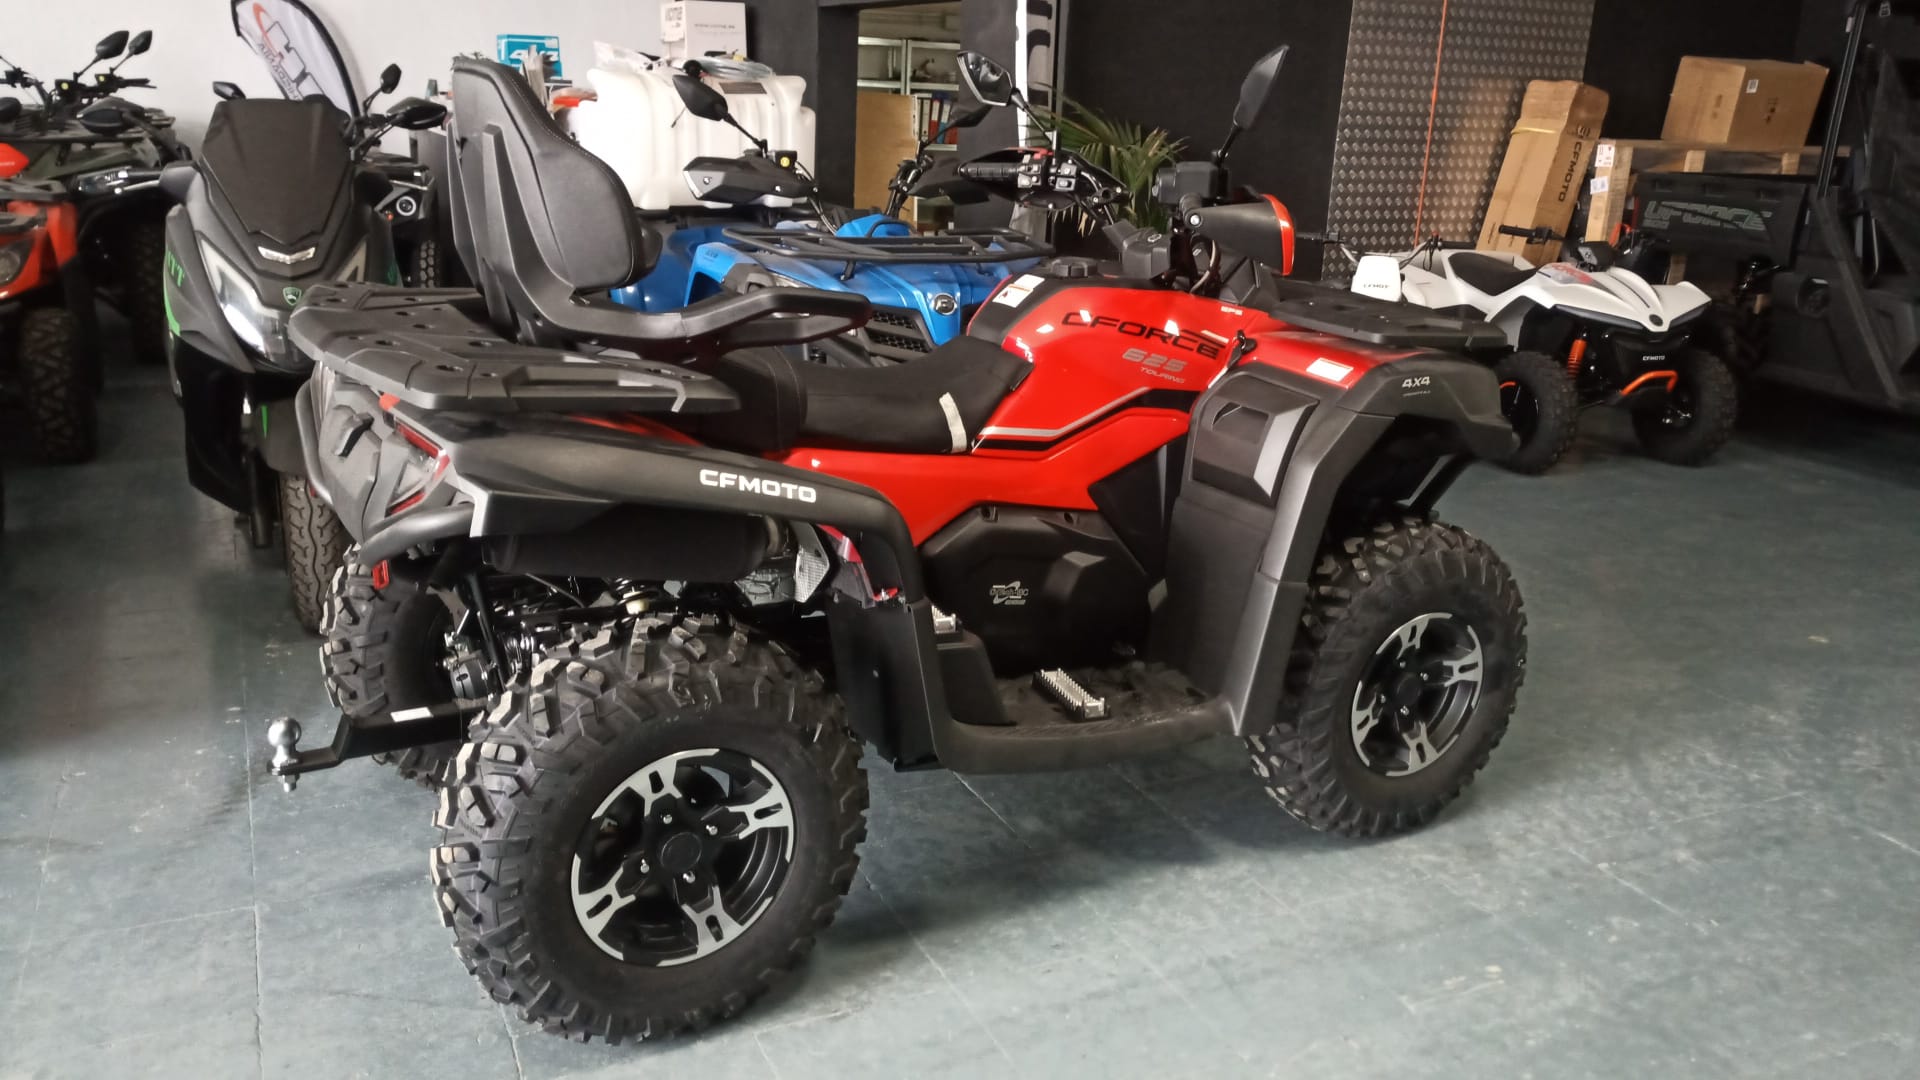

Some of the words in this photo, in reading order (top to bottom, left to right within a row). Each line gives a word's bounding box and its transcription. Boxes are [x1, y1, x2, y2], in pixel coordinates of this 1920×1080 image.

[1558, 141, 1583, 202] CFMOTO
[1062, 311, 1226, 360] CFORCE
[1122, 348, 1188, 373] 625
[1140, 366, 1185, 384] TOURING
[699, 468, 817, 504] CFMOTO
